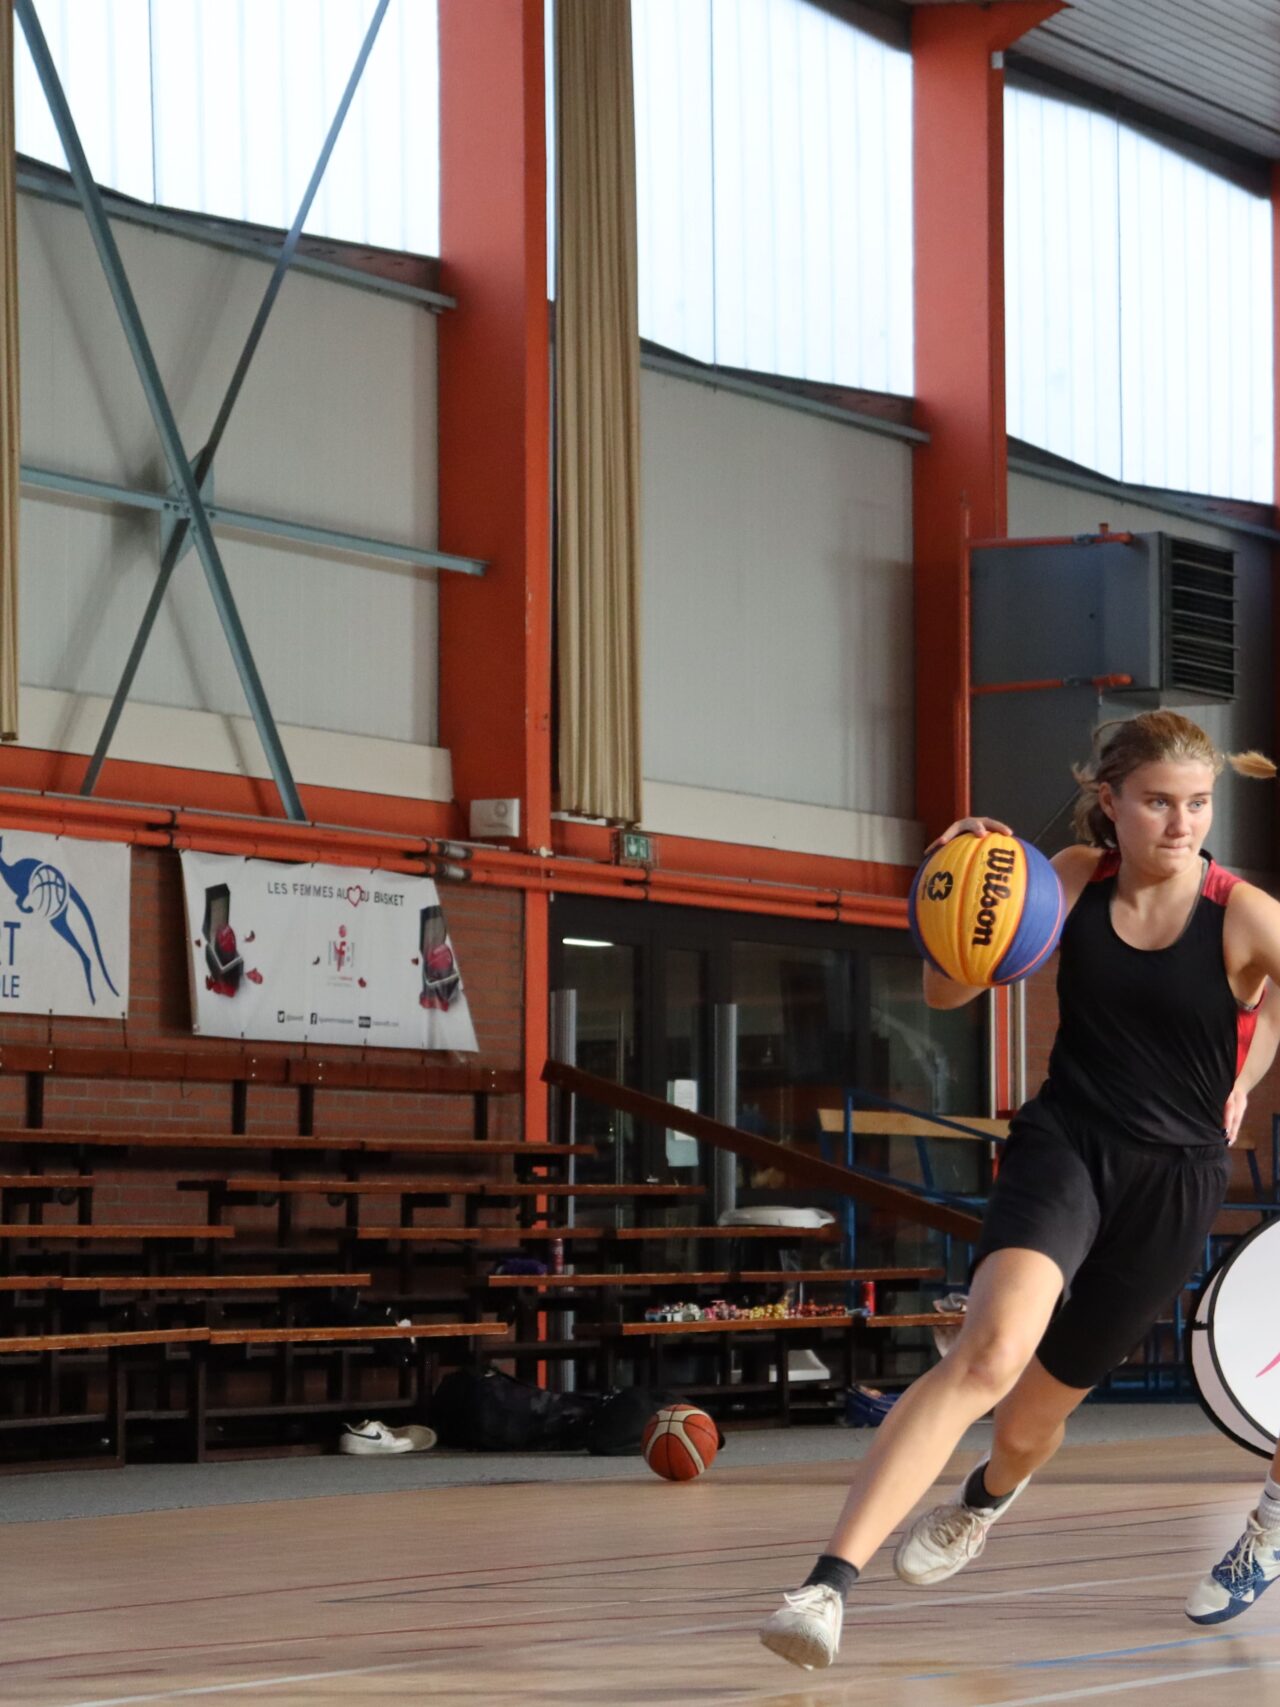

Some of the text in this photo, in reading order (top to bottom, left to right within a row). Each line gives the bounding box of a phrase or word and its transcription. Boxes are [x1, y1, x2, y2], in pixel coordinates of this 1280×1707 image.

[267, 881, 287, 895] LES
[292, 883, 334, 899] FEMMES
[373, 891, 405, 906] BASKET
[972, 848, 1015, 946] Wilson
